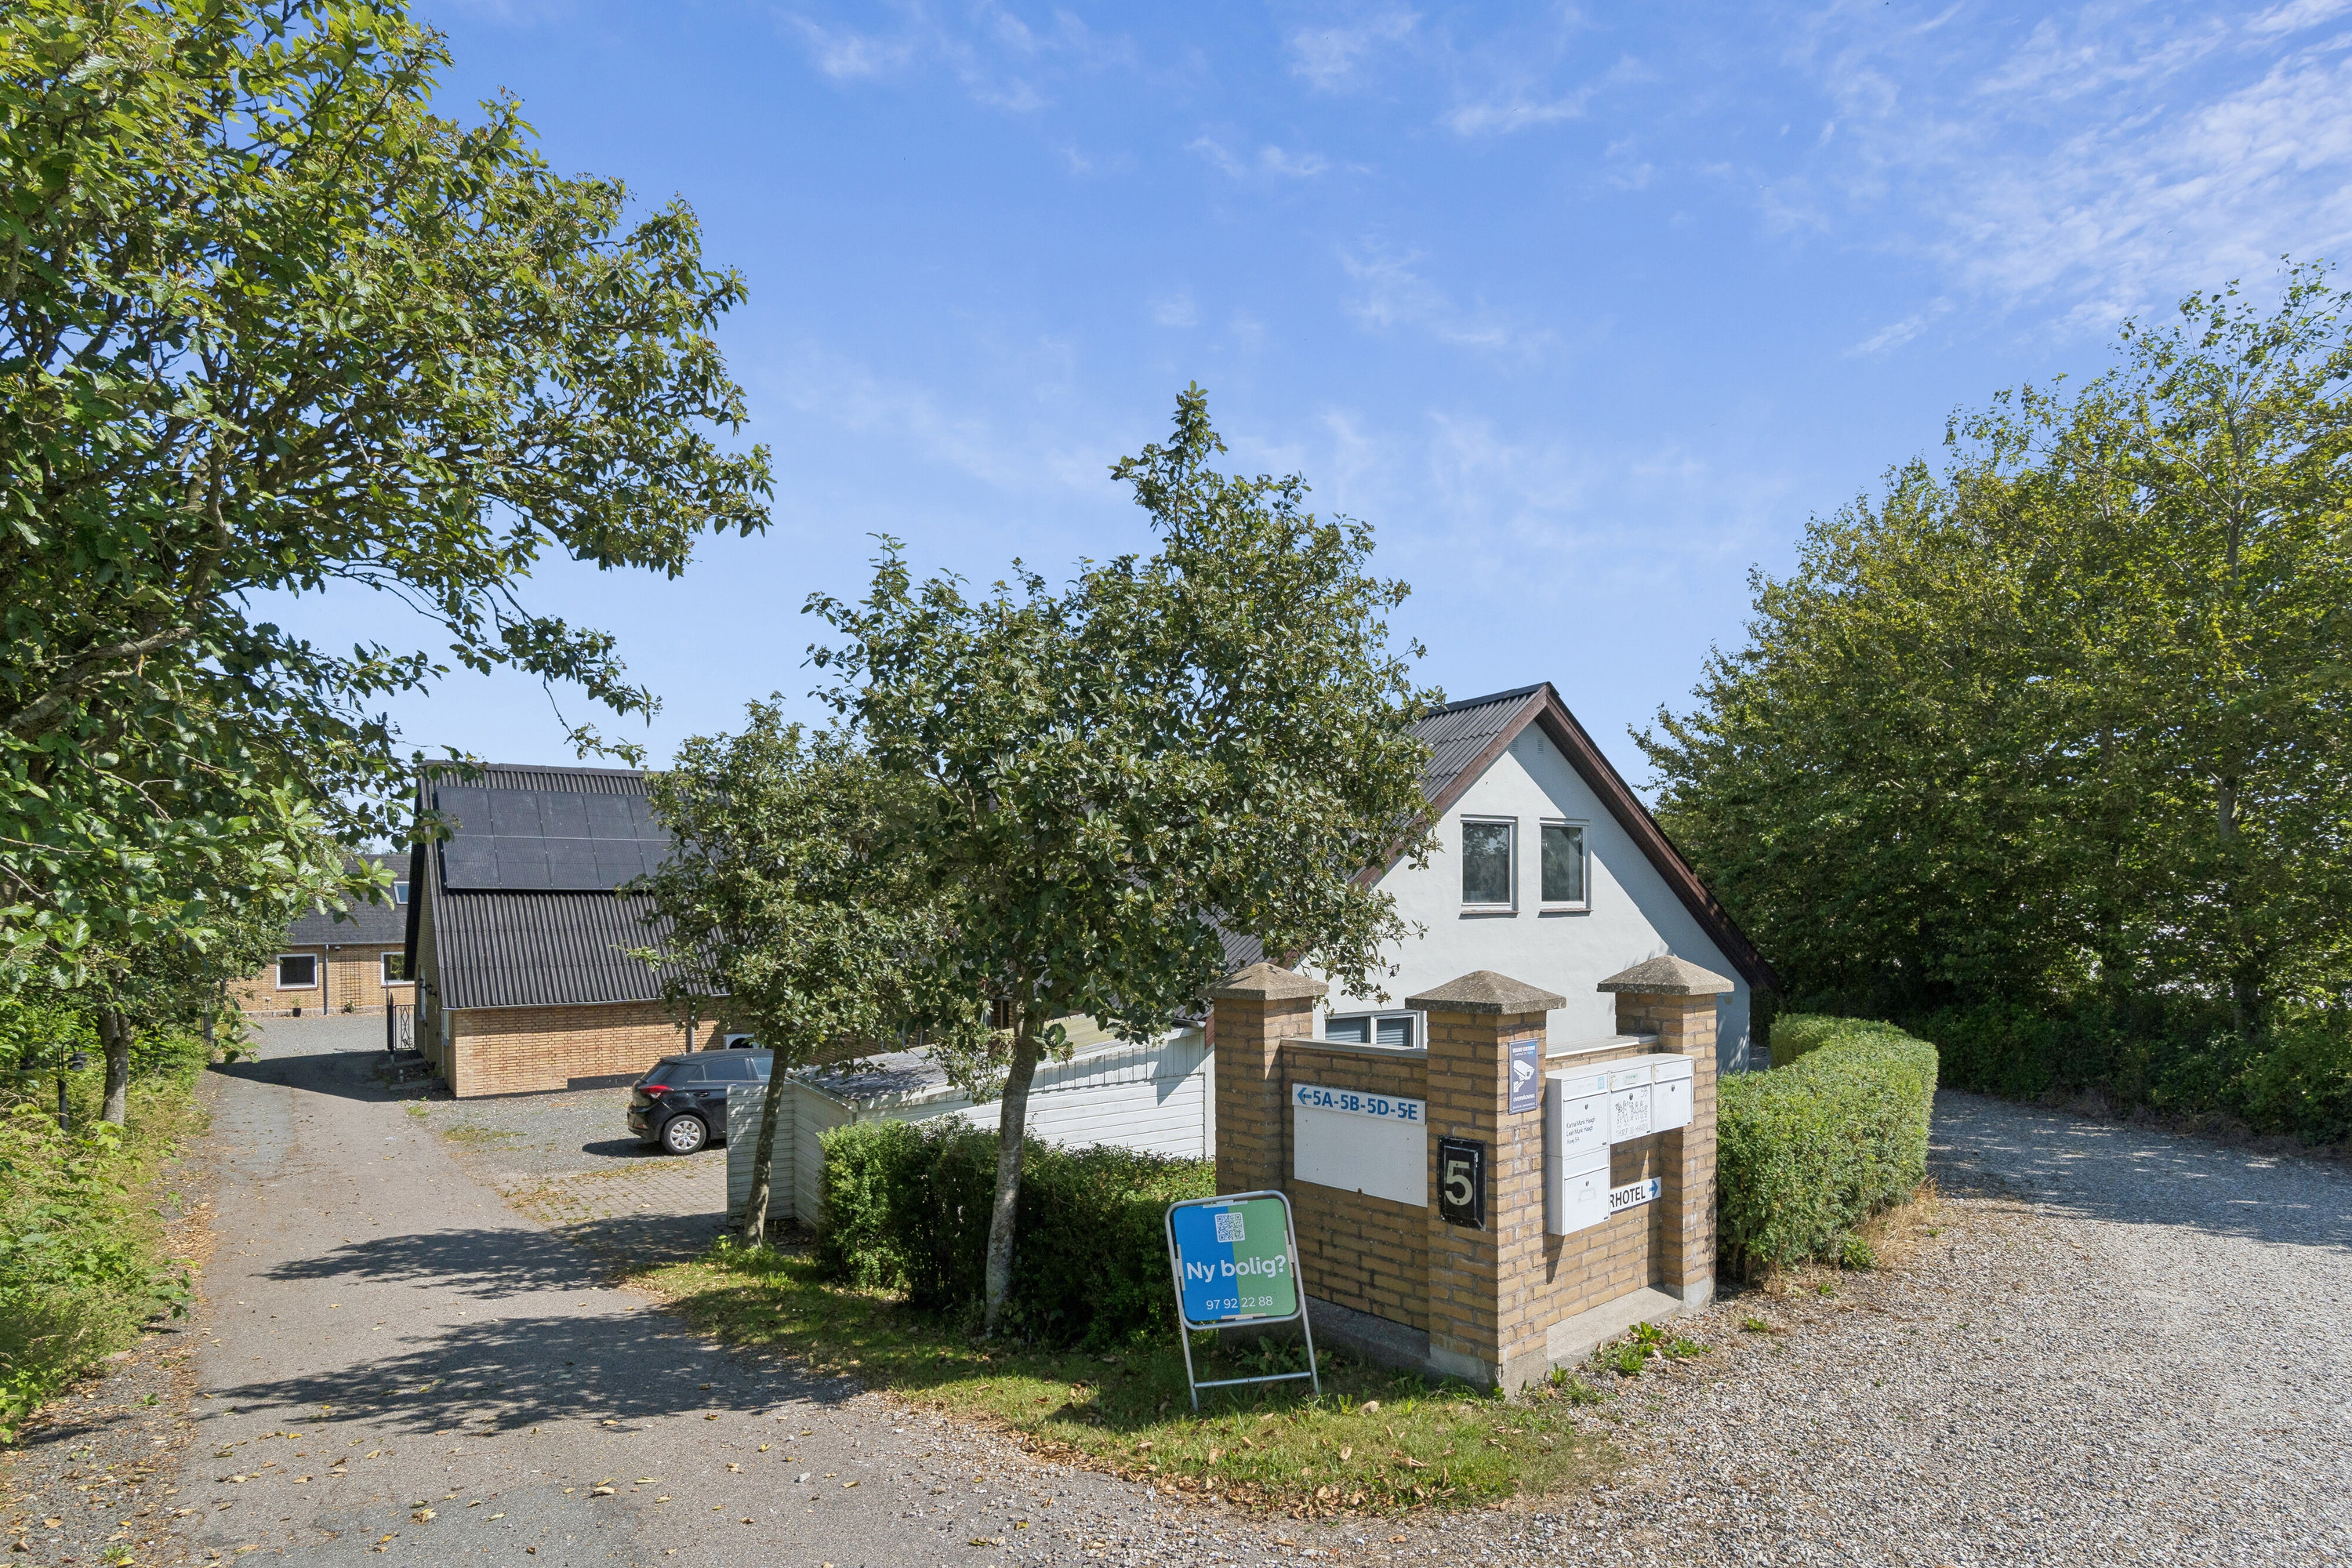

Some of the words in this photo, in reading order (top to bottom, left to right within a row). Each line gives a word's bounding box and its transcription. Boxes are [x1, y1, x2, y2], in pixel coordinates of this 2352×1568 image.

[1445, 1160, 1473, 1206] 5
[1186, 1261, 1216, 1283] Ny
[1220, 1254, 1287, 1279] bolig?
[1206, 1299, 1221, 1310] 97
[1223, 1298, 1239, 1309] 92
[1241, 1297, 1255, 1308] 22
[1258, 1295, 1273, 1307] 88
